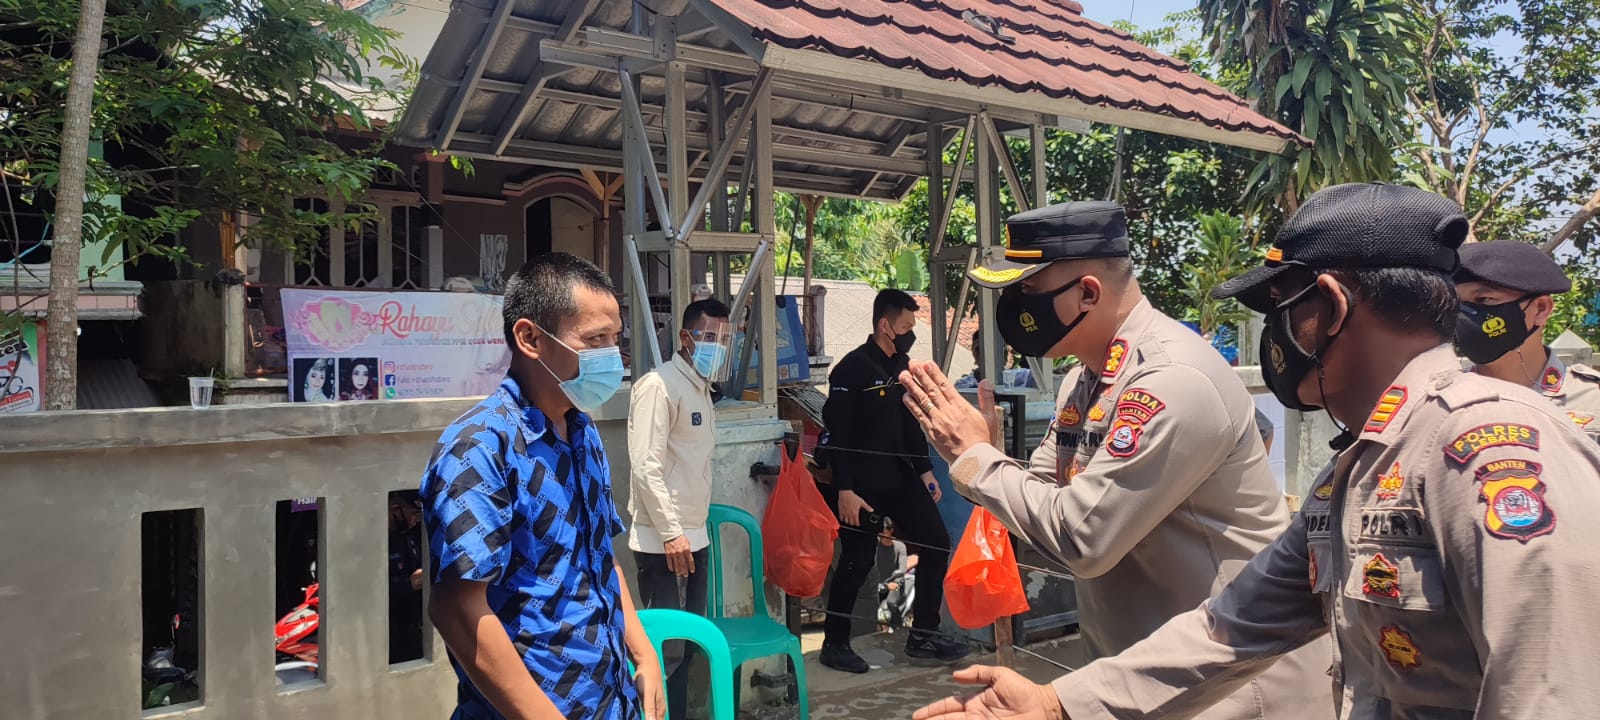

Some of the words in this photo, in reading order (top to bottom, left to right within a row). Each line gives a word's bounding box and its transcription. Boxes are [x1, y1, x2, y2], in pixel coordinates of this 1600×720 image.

[1488, 327, 1508, 339] POLRI
[1120, 391, 1158, 410] POLDA
[1454, 425, 1531, 452] POLRES
[1470, 434, 1519, 453] LEBAK
[1486, 460, 1527, 472] BANTEN
[1362, 511, 1424, 536] POLRI
